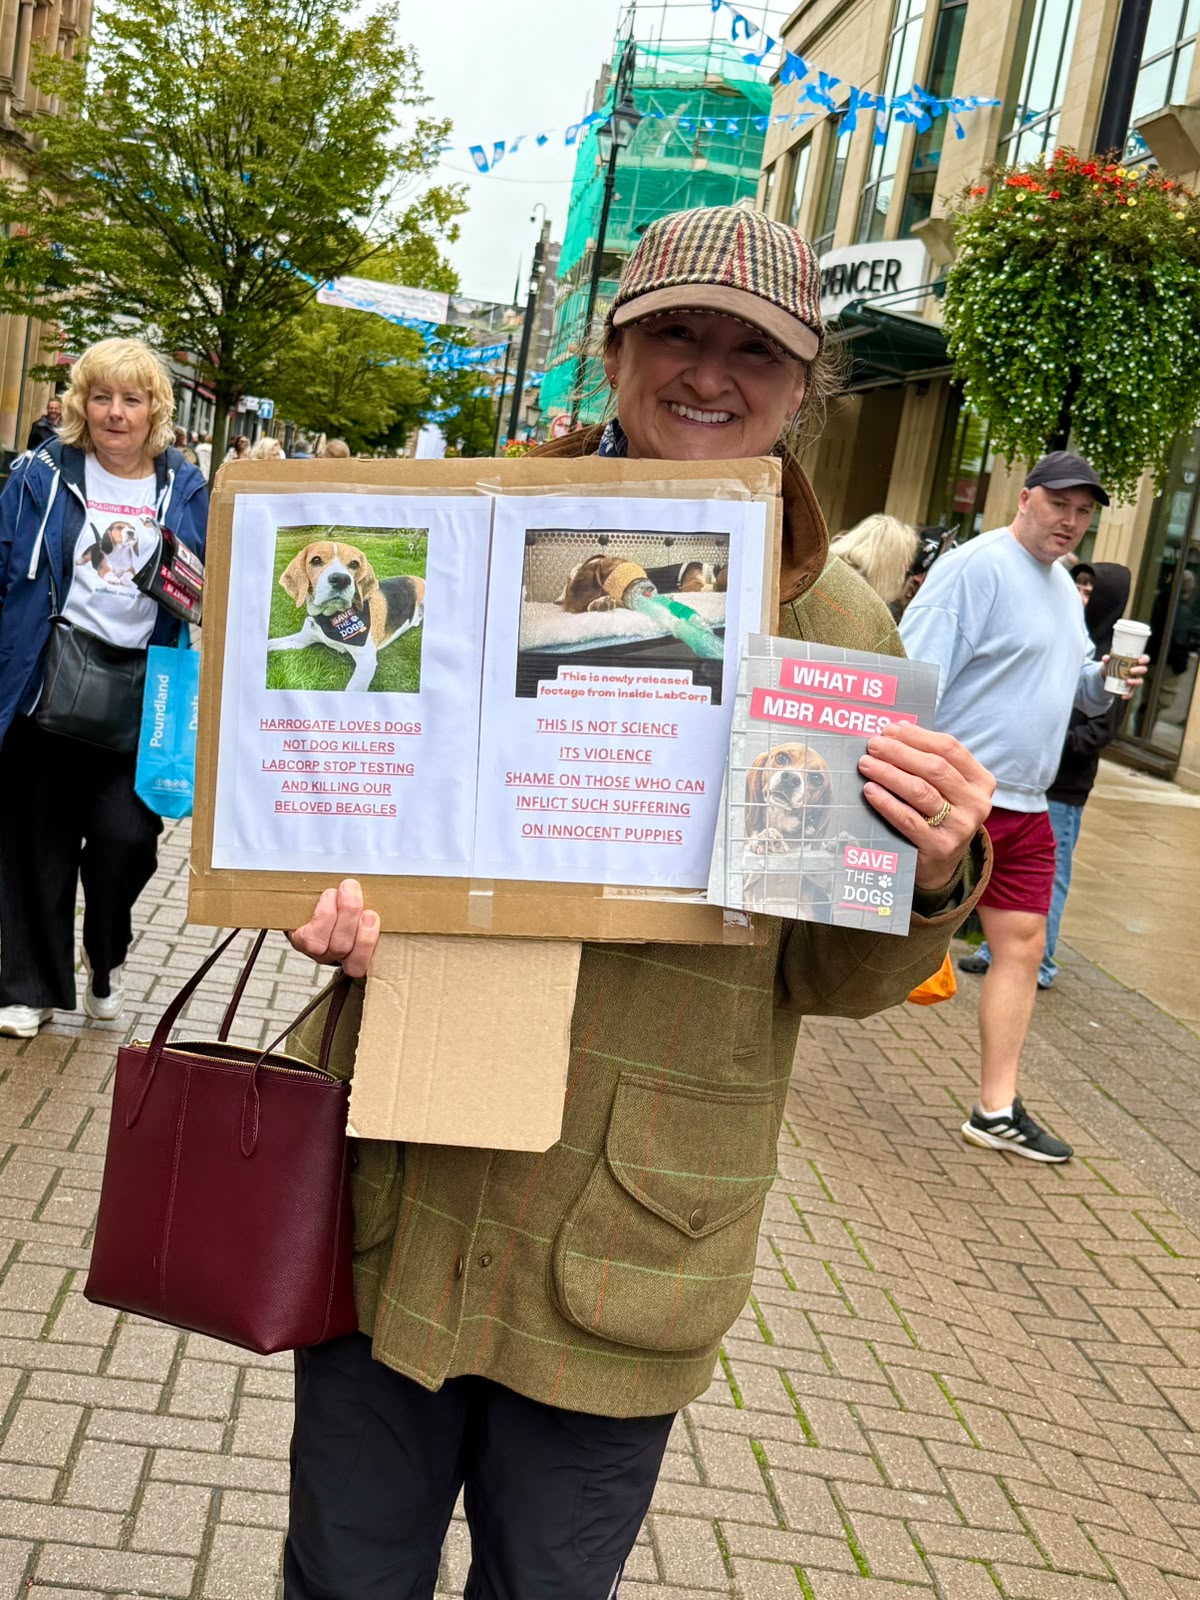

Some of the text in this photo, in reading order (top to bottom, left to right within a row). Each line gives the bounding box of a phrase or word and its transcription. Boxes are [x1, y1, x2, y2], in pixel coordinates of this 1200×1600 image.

[821, 259, 902, 297] PENCER
[336, 619, 352, 630] THE
[340, 620, 365, 638] DOGS
[560, 672, 689, 686] This is newly released
[793, 665, 882, 698] WHAT IS
[540, 686, 708, 704] footage from inside LabCorp
[149, 674, 170, 748] Poundland
[763, 696, 891, 734] MBR ACRES
[260, 718, 422, 732] HARROGATE LOVES DOGS
[537, 718, 678, 736] THIS IS NOT SCIENCE
[284, 739, 396, 752] NOT DOG KILLERS
[560, 746, 652, 761] ITS VIOLENCE
[262, 759, 414, 774] LABCORP STOP TESTING
[282, 780, 392, 794] AND KILLING OUR
[505, 772, 705, 792] SHAME ON THOSE WHO CAN
[275, 800, 397, 814] BELOVED BEAGLES
[516, 796, 690, 814] INFLICT SUCH SUFFERING
[522, 823, 682, 842] ON INNOCENT PUPPIES
[846, 849, 894, 870] SAVE
[845, 870, 874, 886] THE
[842, 885, 894, 907] DOGS
